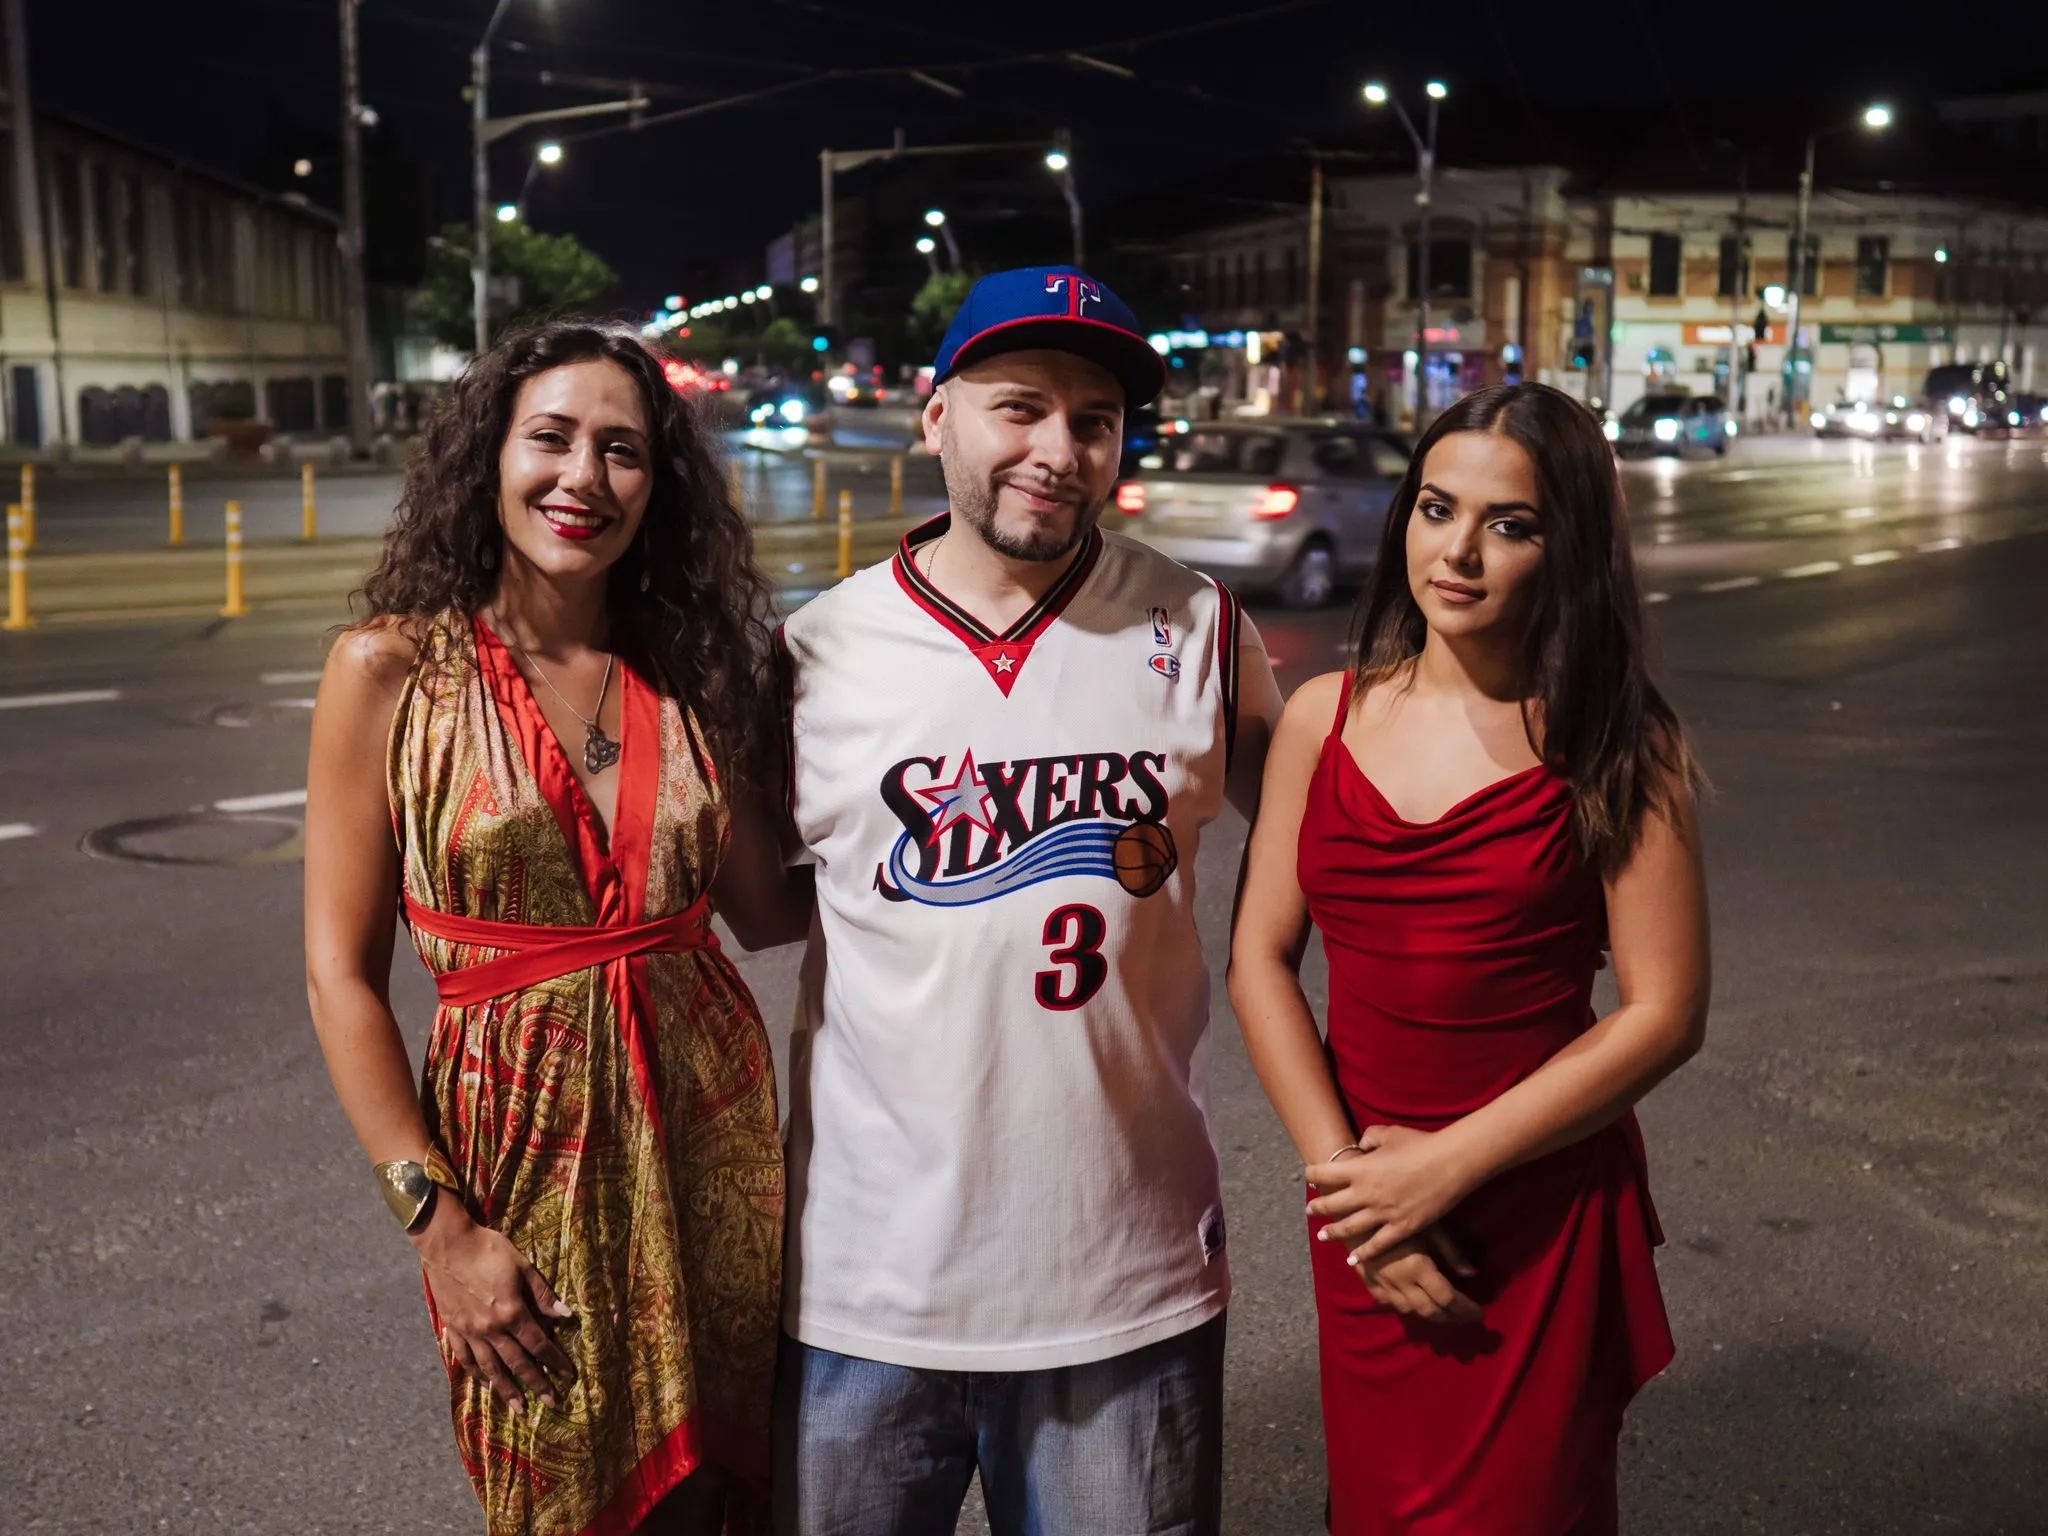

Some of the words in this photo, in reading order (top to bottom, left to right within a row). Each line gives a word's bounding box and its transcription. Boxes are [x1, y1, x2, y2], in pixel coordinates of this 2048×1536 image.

[1045, 273, 1101, 317] T
[872, 746, 1169, 902] SIXERS
[1034, 903, 1108, 1011] 3
